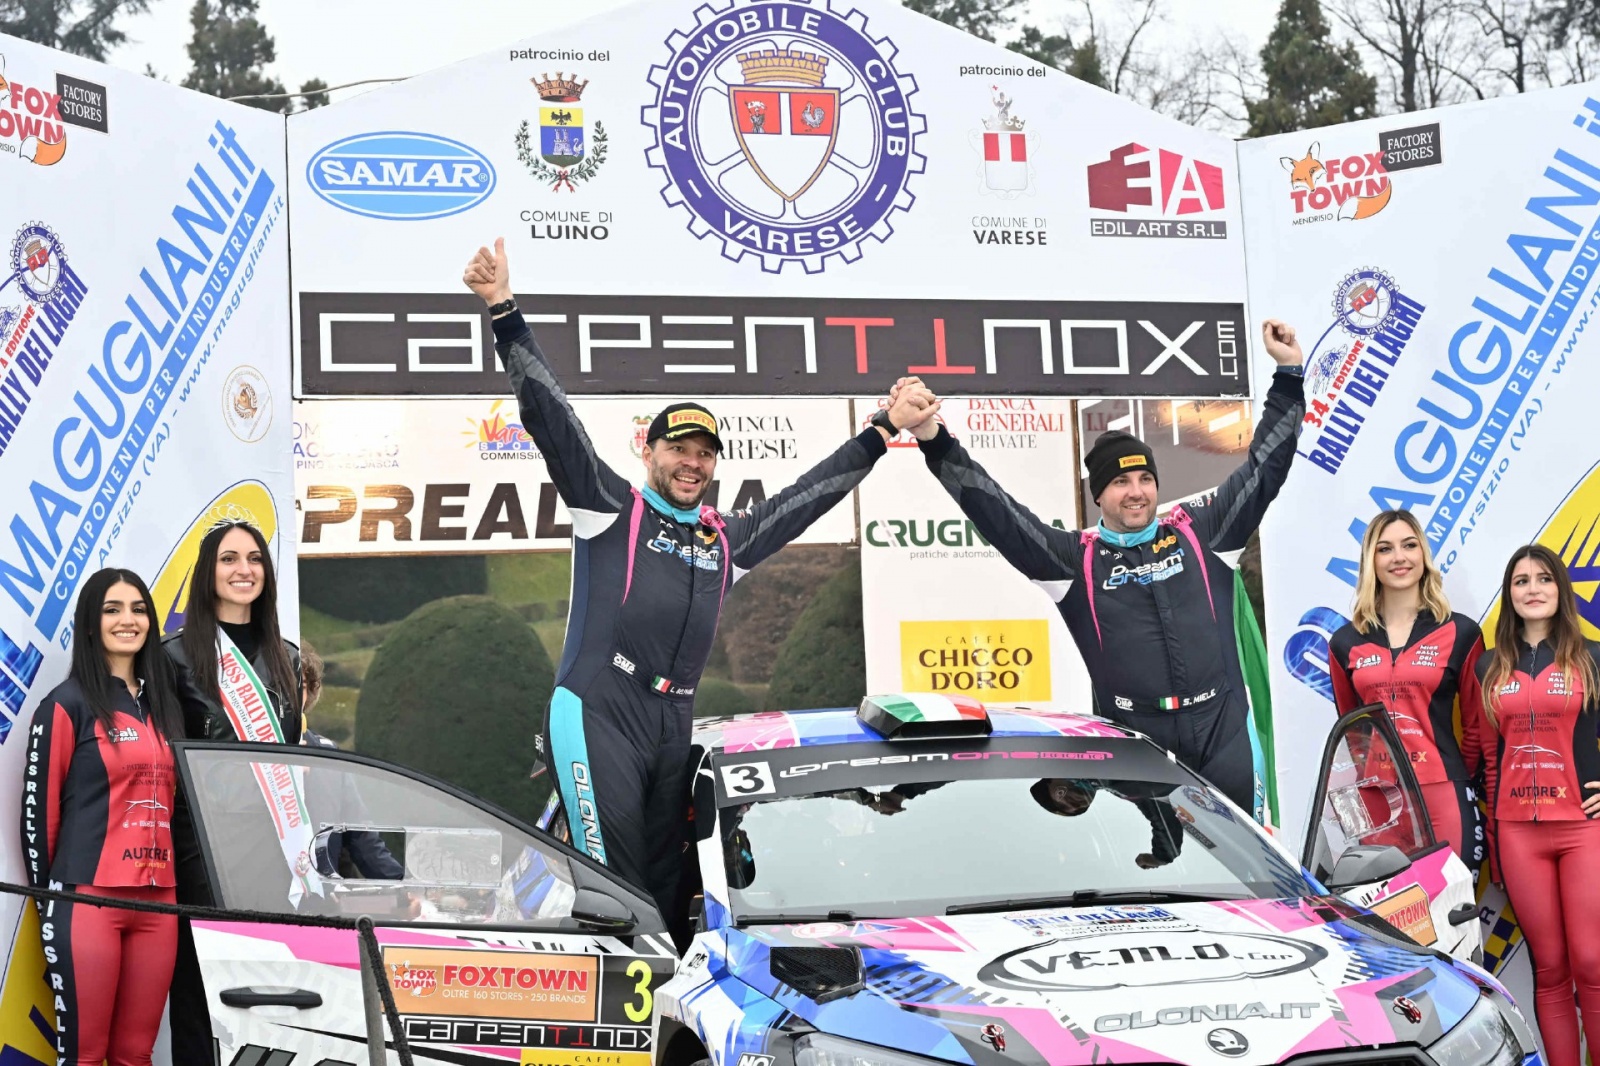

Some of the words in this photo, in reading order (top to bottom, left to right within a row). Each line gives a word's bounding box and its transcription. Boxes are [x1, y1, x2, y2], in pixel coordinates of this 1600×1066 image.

[510, 48, 584, 62] patrocinio
[587, 49, 610, 62] del
[663, 7, 823, 151] AUTOMOBILE
[864, 58, 907, 157] CLUB
[959, 64, 1024, 77] patrocinio
[1026, 66, 1046, 78] del
[10, 81, 64, 122] FOX
[63, 84, 102, 107] FACTORY
[63, 100, 102, 122] STORES
[0, 109, 64, 144] OWN
[1386, 131, 1434, 151] FACTORY
[1325, 150, 1388, 183] FOX
[1387, 145, 1434, 164] STORES
[1290, 176, 1388, 214] TOWN
[519, 210, 591, 223] COMUNE
[598, 211, 613, 223] DI
[530, 224, 609, 240] LUINO
[723, 209, 864, 254] VARESE
[971, 215, 1029, 229] COMUNE
[1034, 217, 1047, 229] DI
[1091, 221, 1133, 236] EDIL
[1136, 222, 1172, 237] ART
[1175, 223, 1226, 238] S.R.L.
[1292, 213, 1334, 226] MENDRISIO
[973, 229, 1047, 246] VARESE
[13, 227, 37, 285] AUTOMOBILE
[46, 232, 64, 260] CLUB
[35, 262, 89, 348] LAGHI
[1335, 273, 1361, 327] AUTOMOBILE
[1373, 272, 1394, 291] CLUB
[4, 304, 36, 359] EDIZIONE
[1365, 309, 1396, 335] VARESE
[1366, 292, 1426, 367] LAGHI
[14, 328, 53, 388] DEI
[98, 480, 142, 568] Arsizio
[142, 421, 170, 476] (VA)
[178, 194, 285, 403] www.magugliani.it
[1303, 399, 1330, 428] 34
[1326, 392, 1337, 401] A
[1332, 339, 1365, 391] EDIZIONE
[1344, 359, 1390, 408] DEI
[0, 368, 32, 458] ALLY
[53, 422, 146, 600] COMPONENTI
[145, 371, 174, 416] PER
[174, 211, 256, 361] L'INDUSTRIA
[481, 412, 534, 445] Vare
[966, 413, 1066, 433] GENERALI
[1307, 399, 1366, 475] RALLY
[480, 442, 538, 450] SPOR
[480, 451, 545, 460] COMMISSIO
[969, 434, 1038, 449] PRIVATE
[1426, 406, 1510, 543] MPONENTI
[1508, 349, 1544, 396] PER
[1459, 457, 1511, 546] Arsizio
[1510, 397, 1543, 451] (VA)
[909, 550, 949, 561] pratiche
[952, 550, 1001, 559] automobil
[944, 632, 1006, 646] CAFFÈ
[613, 653, 636, 674] OMP
[918, 647, 1034, 668] CHICCO
[217, 652, 246, 685] MISS
[236, 682, 268, 724] RALLY
[930, 669, 1021, 691] D'ORO
[221, 677, 231, 692] by
[228, 688, 248, 723] Eugenio
[1115, 696, 1134, 710] OMP
[1193, 688, 1217, 704] MIELE
[28, 724, 43, 776] MISS
[731, 764, 771, 796] 3
[1509, 786, 1567, 799] AUTOREX
[25, 781, 38, 844] RALLY
[280, 790, 301, 829] 2026
[28, 847, 39, 884] DEI
[1385, 899, 1428, 930] OXTOWN
[393, 979, 437, 990] TOWN
[409, 969, 436, 980] FOX
[442, 964, 588, 993] FOXTOWN
[441, 989, 470, 999] OLTRE
[472, 990, 488, 1000] 160
[489, 991, 524, 1001] STORES
[530, 992, 548, 1003] 250
[550, 993, 586, 1004] BRANDS
[623, 959, 653, 1023] 3
[1093, 1001, 1320, 1034] OLONIA.IT
